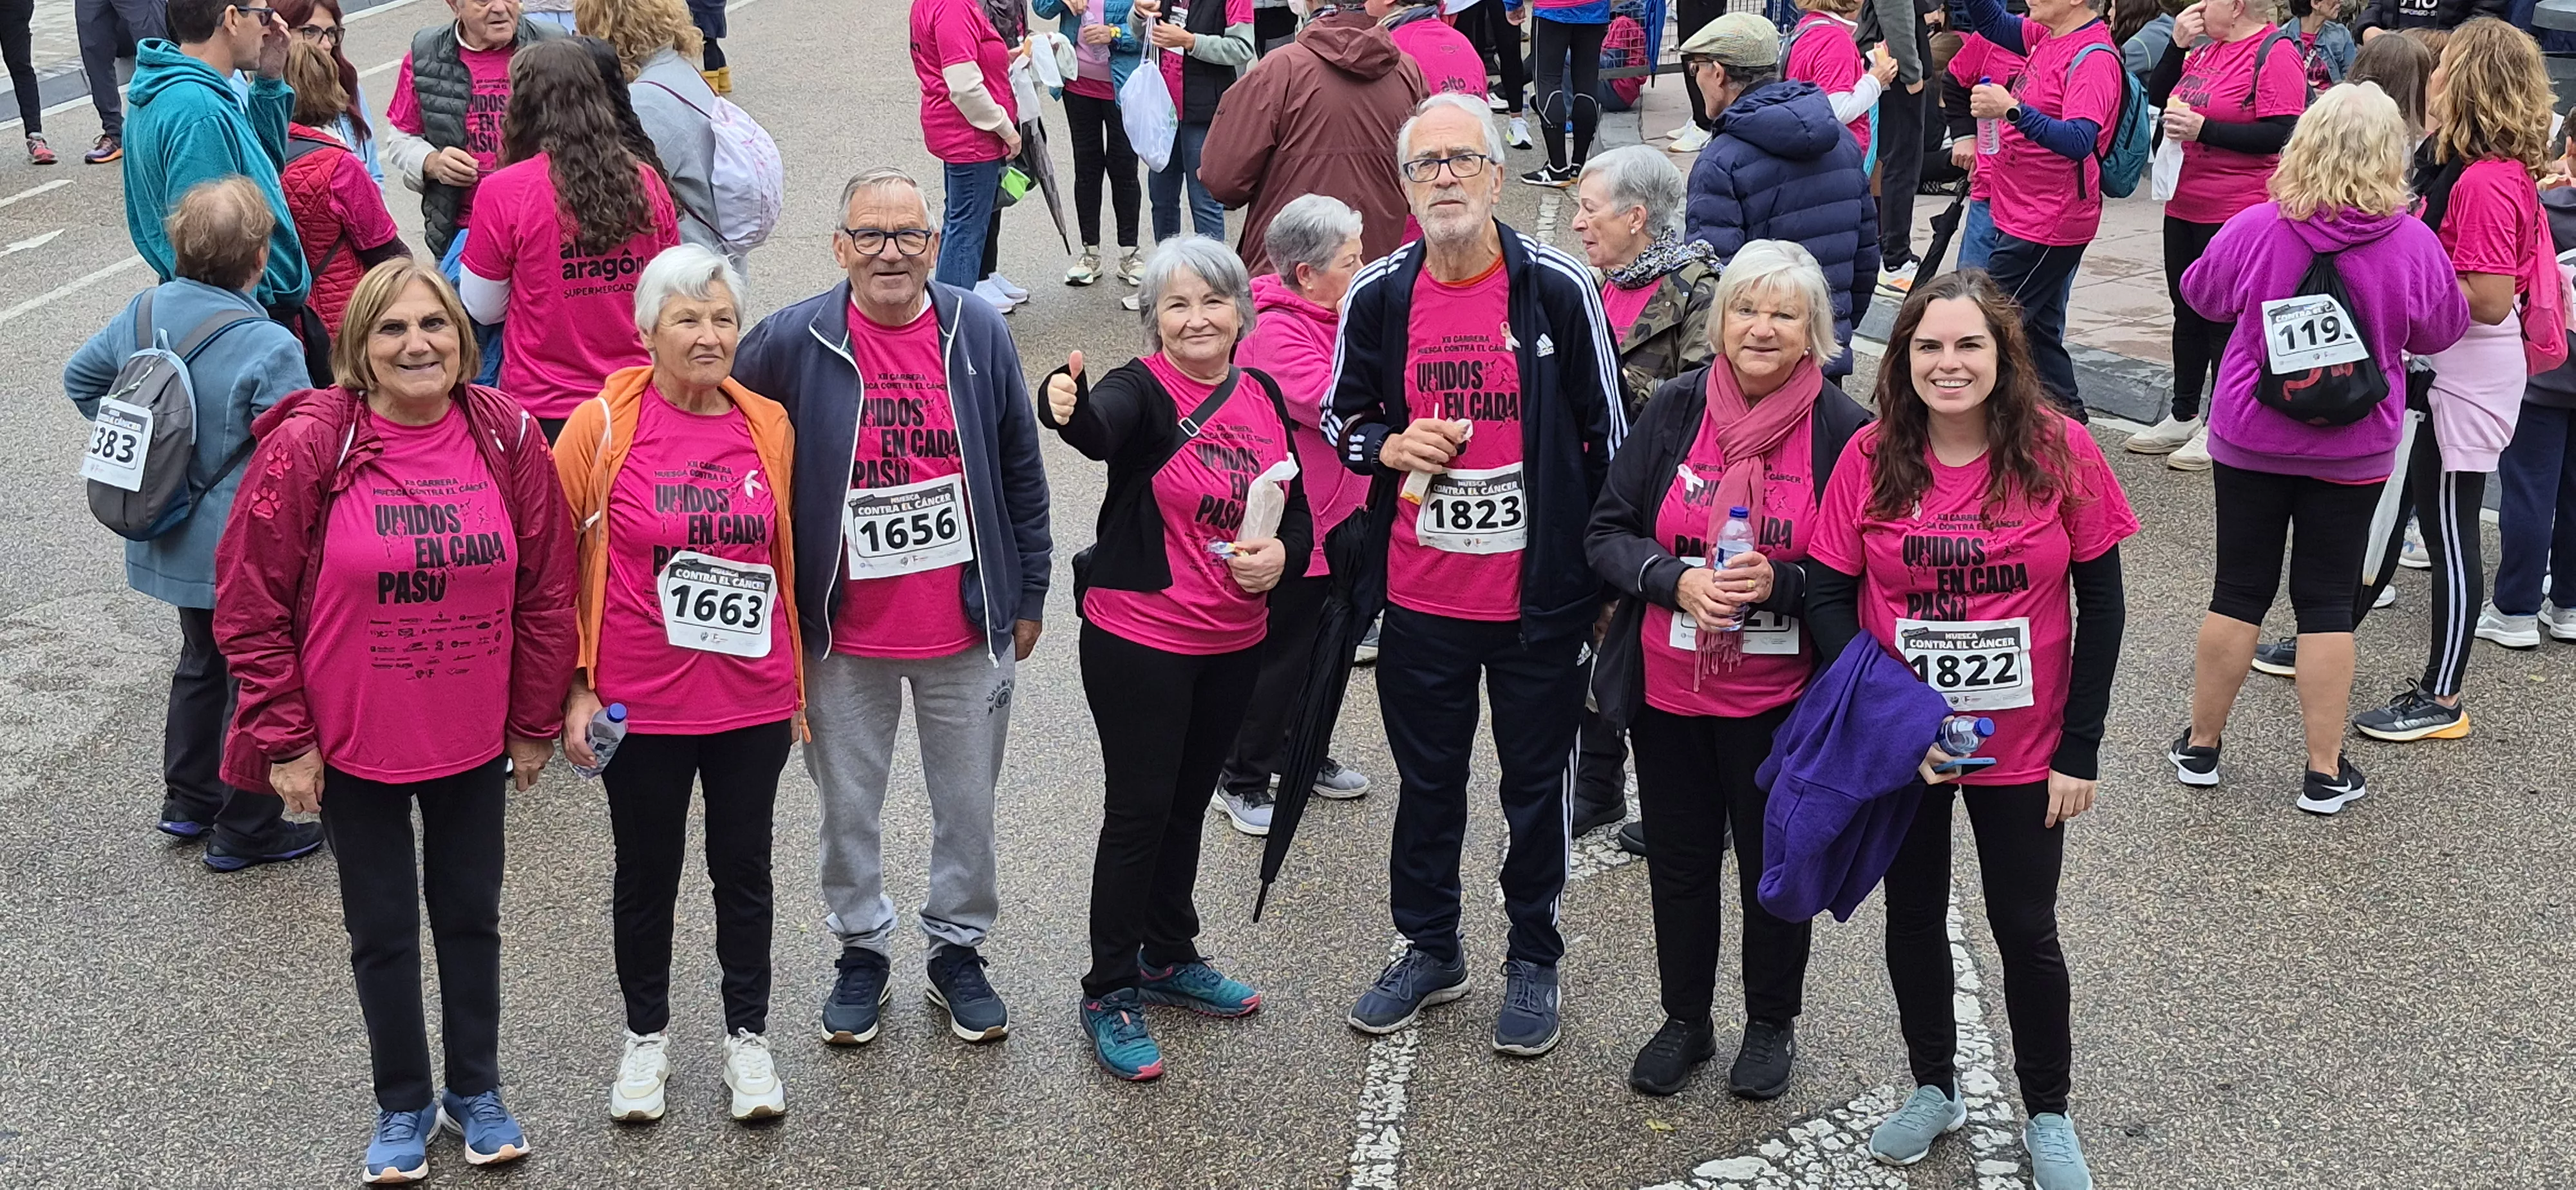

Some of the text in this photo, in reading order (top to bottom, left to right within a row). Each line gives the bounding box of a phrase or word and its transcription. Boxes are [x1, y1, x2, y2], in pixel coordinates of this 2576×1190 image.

[564, 283, 637, 299] SUPERMERCAD
[2278, 316, 2353, 350] 119
[1417, 360, 1484, 392] UNIDOS
[1443, 392, 1519, 420] EN CADA
[881, 430, 906, 457] EN
[417, 478, 459, 487] CARRERA
[1434, 484, 1466, 495] CONTRA
[1481, 481, 1519, 495] CÁNCER
[654, 484, 730, 513] UNIDOS
[858, 505, 900, 515] CONTRA
[914, 493, 952, 509] CÁNCER
[1430, 496, 1522, 529] 1823
[375, 504, 462, 536] UNIDOS
[688, 515, 766, 545] EN CADA
[860, 506, 956, 552] 1656
[415, 531, 506, 569] EN CADA
[1903, 534, 1985, 567] UNIDOS
[377, 570, 446, 604] PASO
[676, 569, 717, 583] CONTRA
[719, 575, 730, 585] EL
[1937, 563, 2029, 594] EN CADA
[670, 584, 763, 628] 1663
[1906, 592, 1967, 621] PASO
[1909, 638, 2016, 649] CONTRA EL CÁNCER
[1910, 652, 2018, 688] 1822
